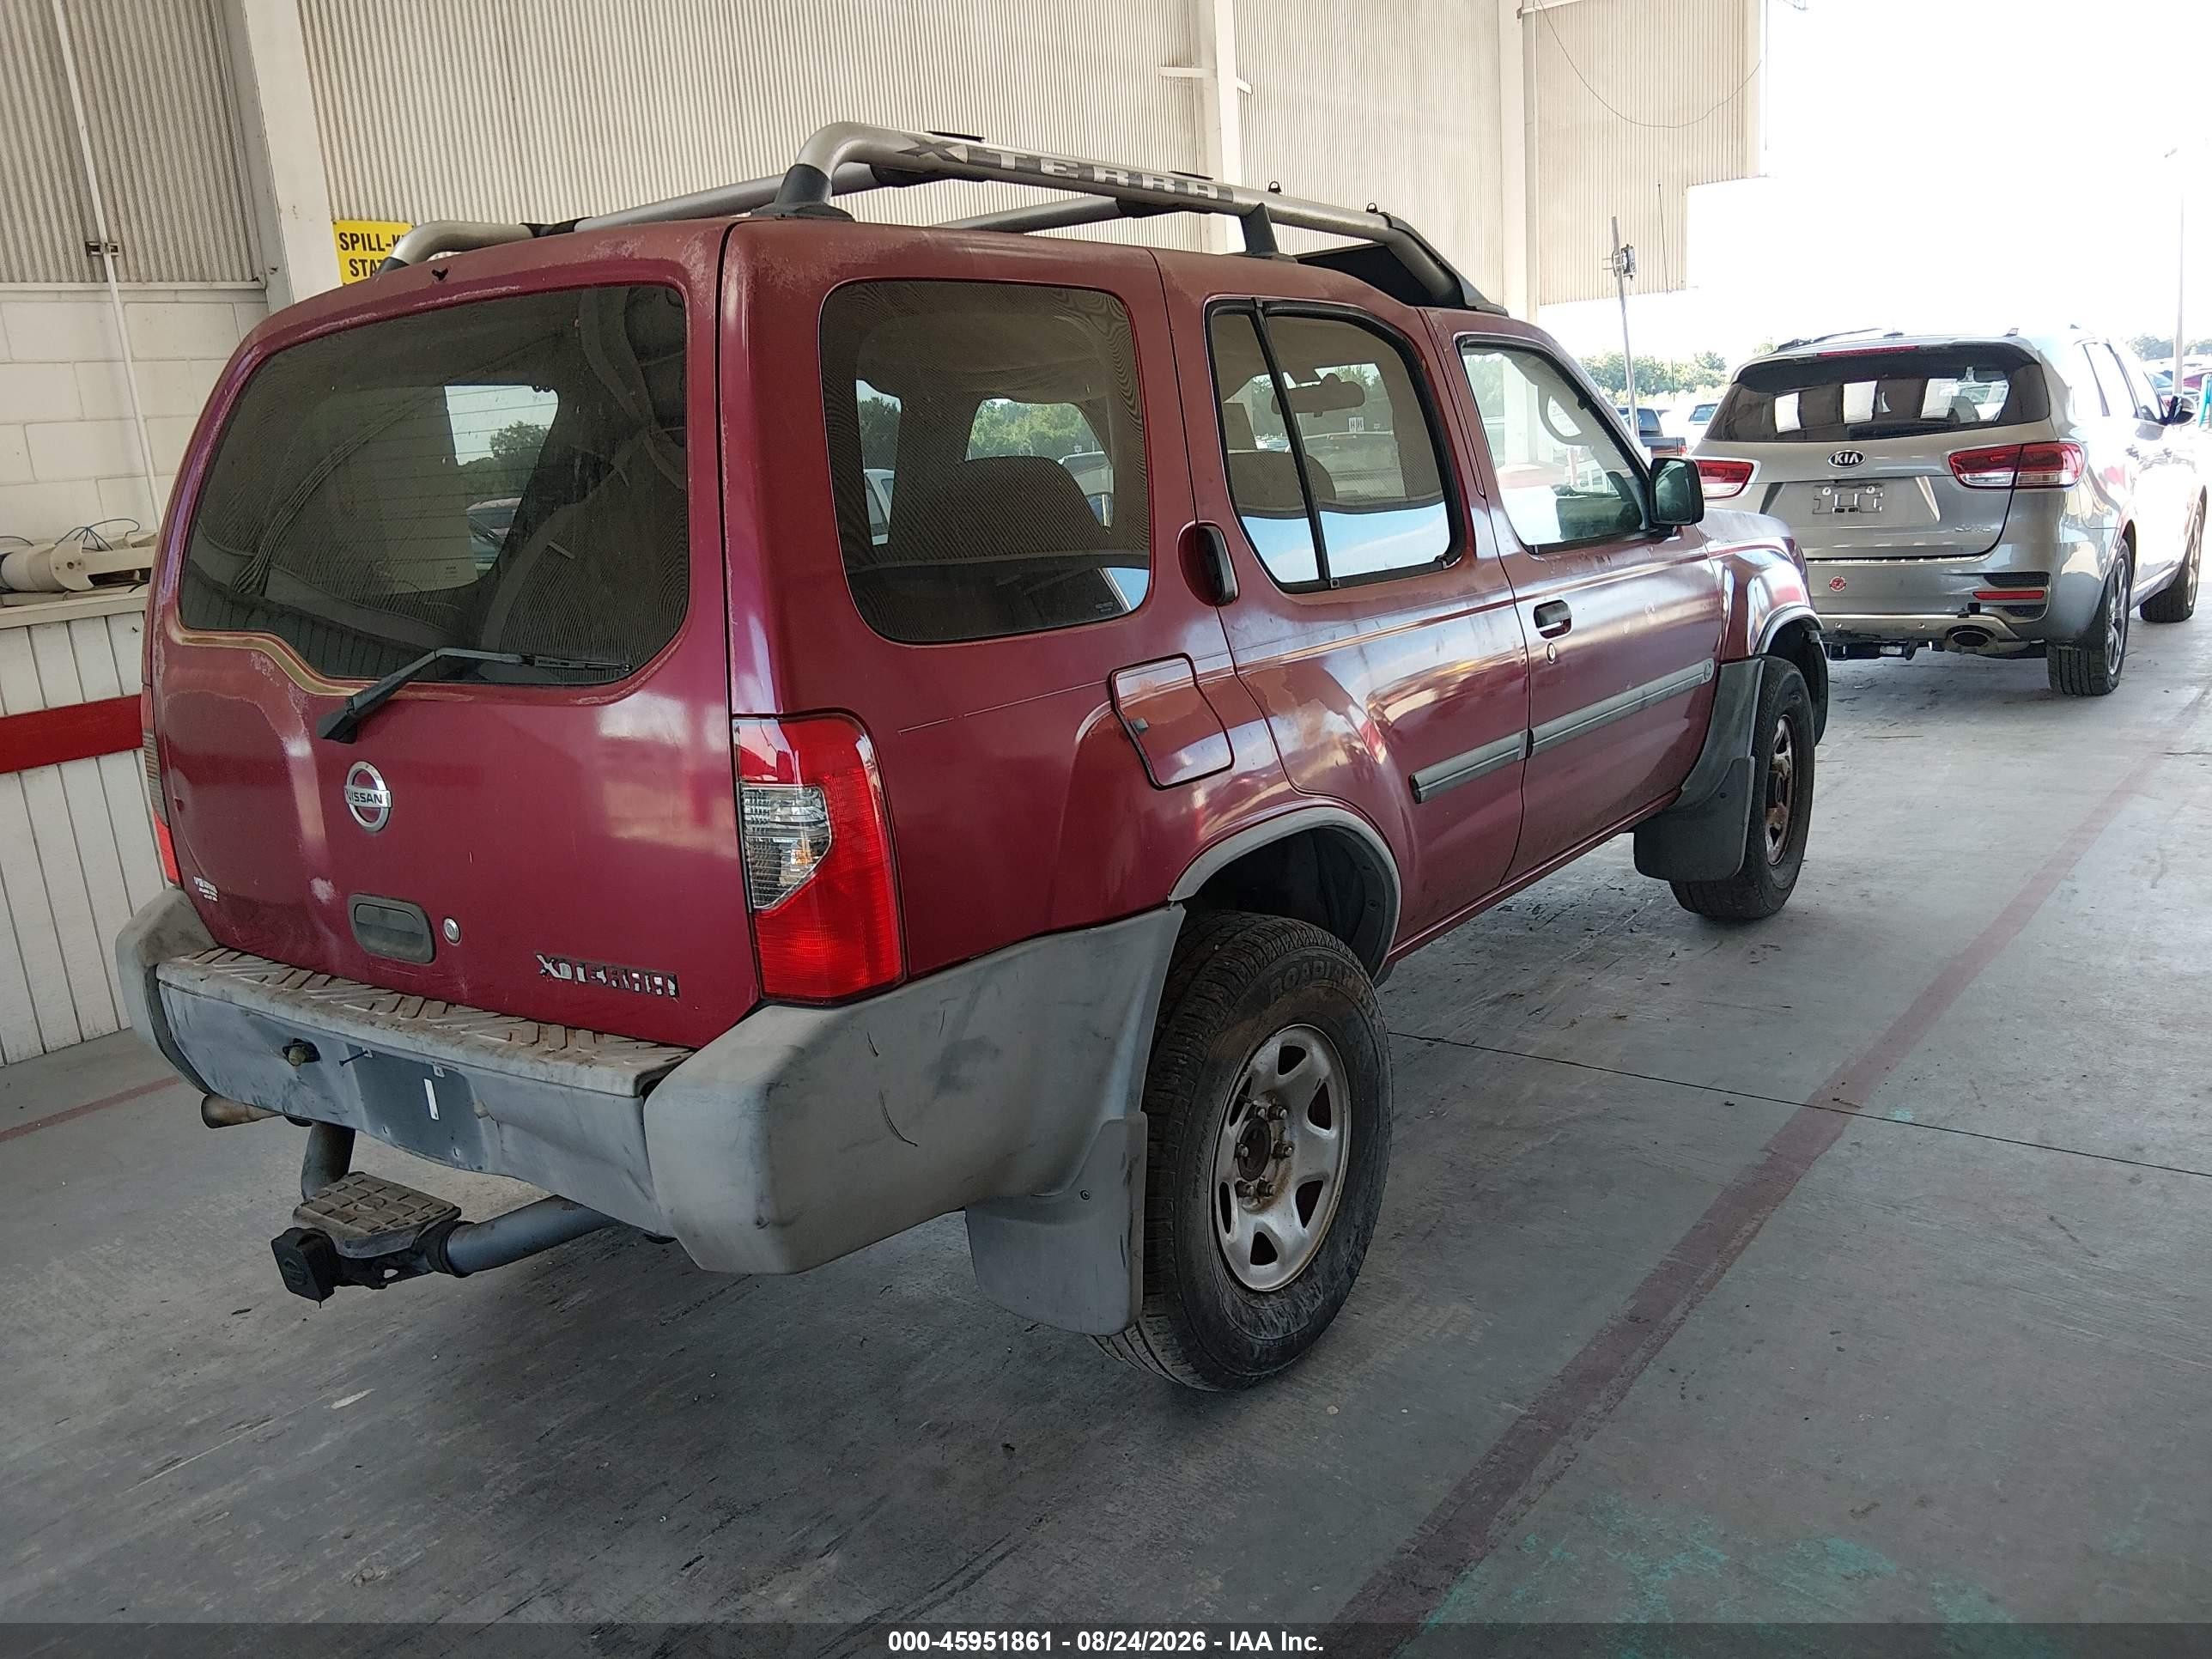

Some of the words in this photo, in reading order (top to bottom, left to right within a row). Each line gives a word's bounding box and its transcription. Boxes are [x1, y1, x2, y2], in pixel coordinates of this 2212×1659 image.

[896, 134, 1219, 201] XTERRA
[338, 232, 404, 252] SPILL-K
[1834, 453, 1859, 464] KIA
[346, 789, 383, 805] NISSAN
